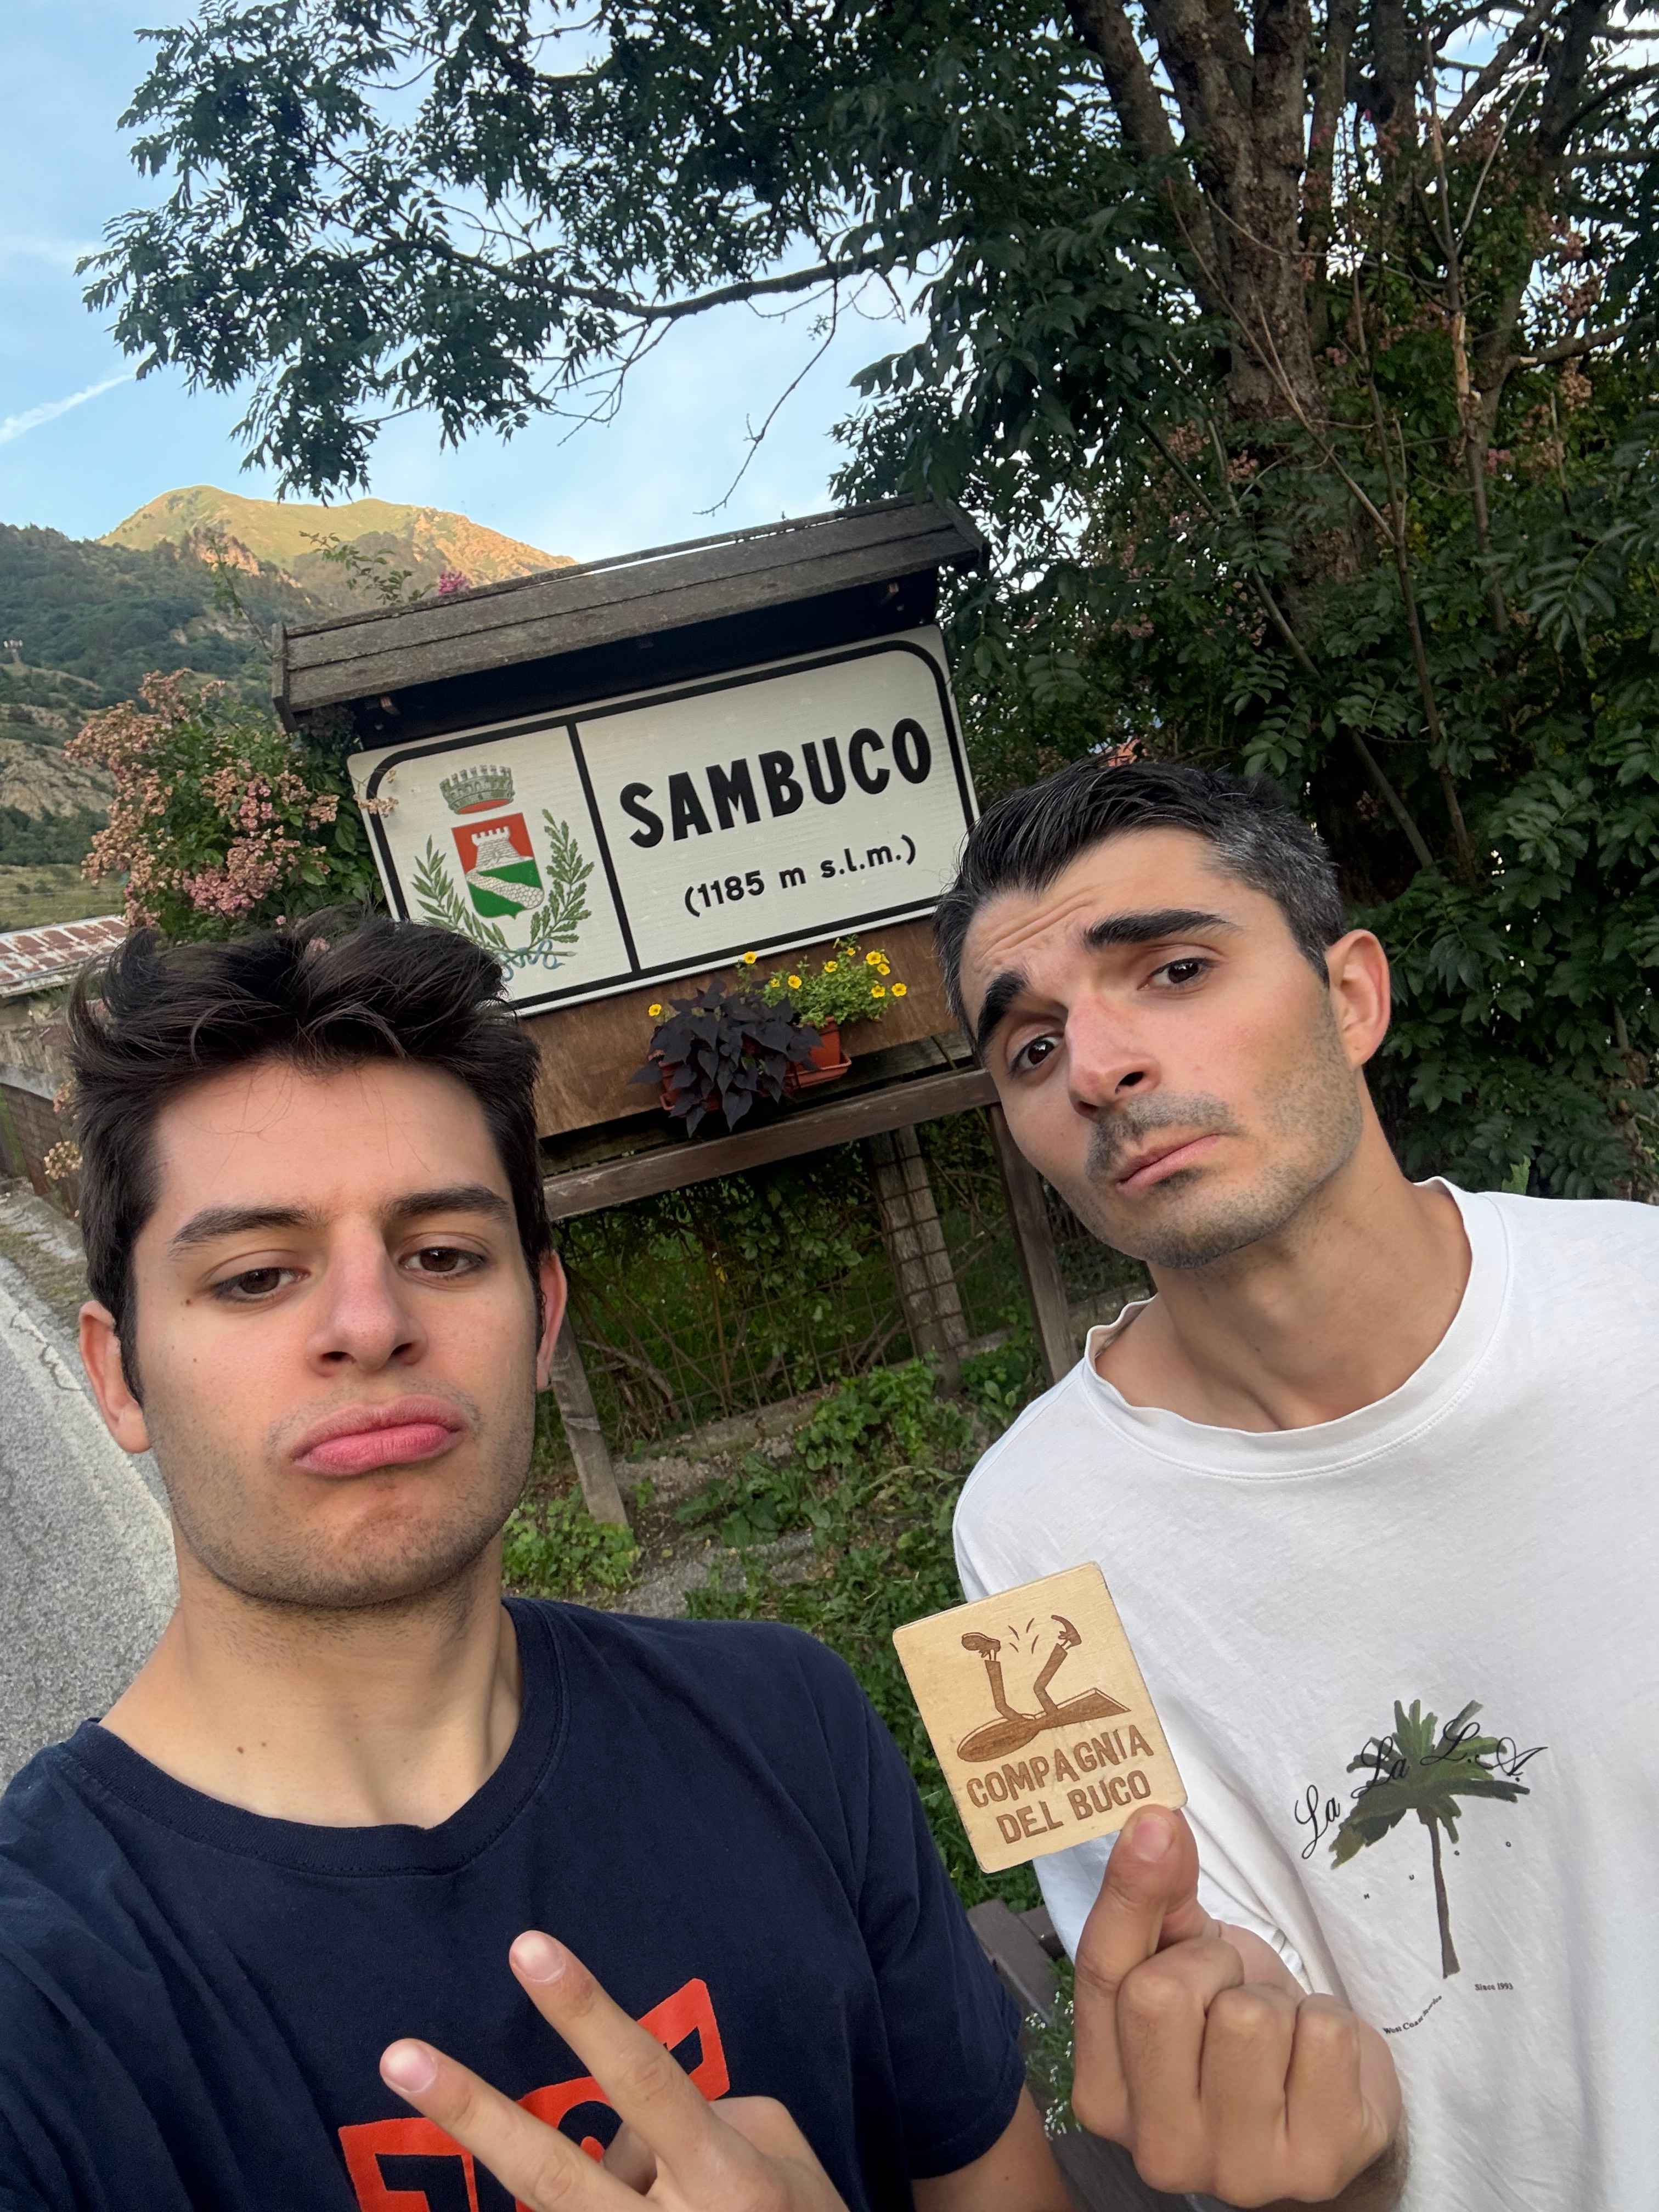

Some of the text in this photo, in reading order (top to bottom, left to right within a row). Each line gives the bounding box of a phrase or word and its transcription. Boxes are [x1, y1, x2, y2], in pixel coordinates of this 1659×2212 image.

[620, 717, 932, 849] SAMBUCO
[684, 834, 916, 918] (1185 m s.l.m.)
[966, 1724, 1155, 1809] COMPAGNIA
[995, 1769, 1152, 1845] DEL BUCO
